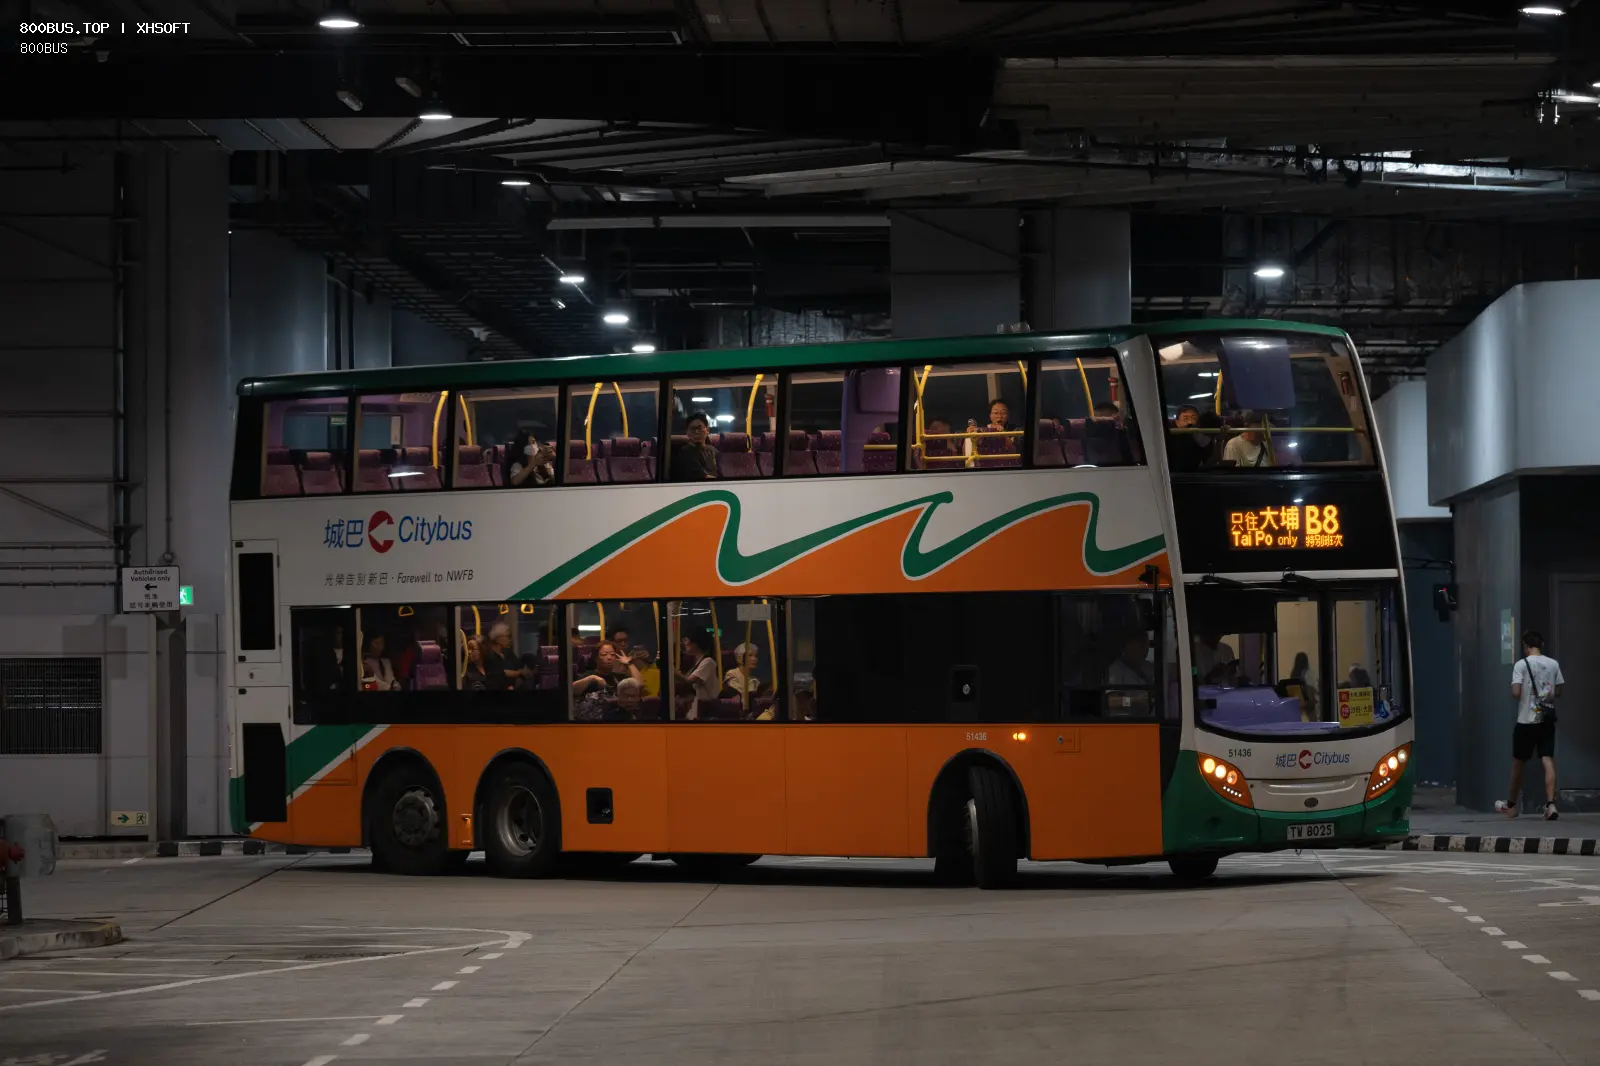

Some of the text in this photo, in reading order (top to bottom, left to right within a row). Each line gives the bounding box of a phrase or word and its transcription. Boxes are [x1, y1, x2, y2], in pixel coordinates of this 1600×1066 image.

[1231, 506, 1299, 531] 只往大埔
[1305, 505, 1339, 534] B8
[323, 515, 473, 549] 城巴 Citybus
[1232, 530, 1298, 548] Tai Po only
[324, 572, 388, 587] 光榮告別新巴
[396, 572, 431, 584] Farewell
[434, 572, 443, 582] to
[446, 569, 474, 582] NWFB
[966, 732, 987, 741] 51436
[1228, 748, 1252, 758] 51436
[1275, 752, 1350, 768] 城巴 Citybus
[1307, 825, 1332, 837] 8025
